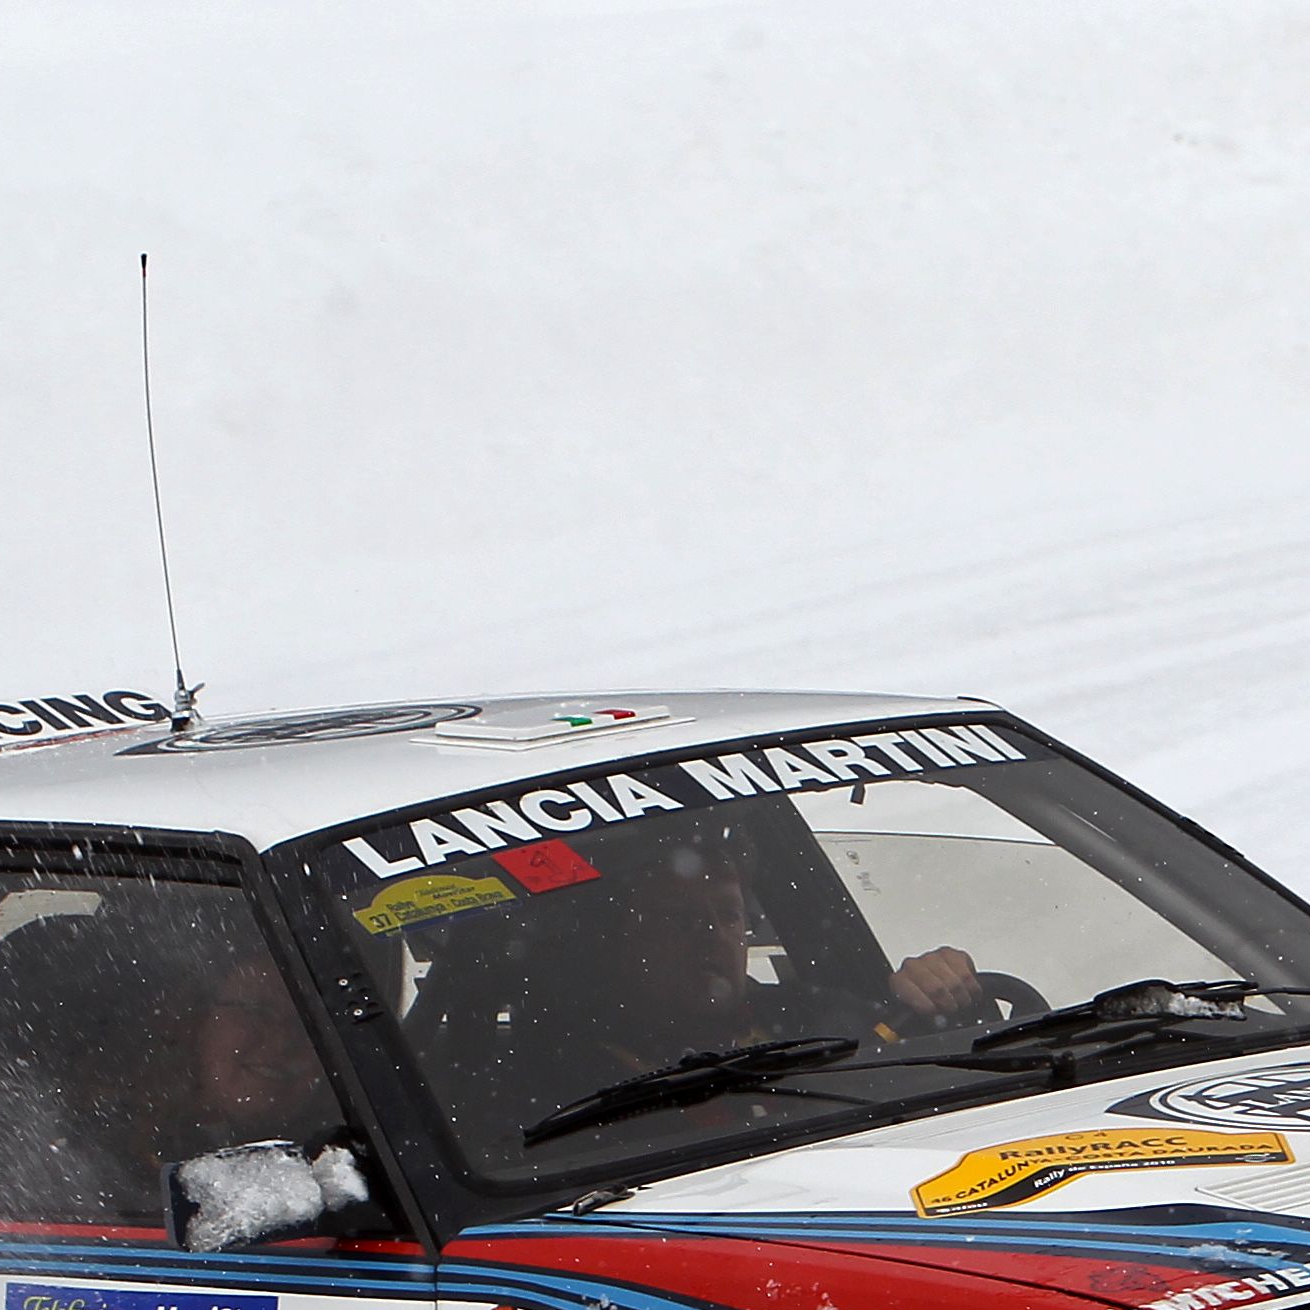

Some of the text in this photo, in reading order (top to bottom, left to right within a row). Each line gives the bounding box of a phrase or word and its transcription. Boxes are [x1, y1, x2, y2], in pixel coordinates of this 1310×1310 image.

[342, 725, 1027, 879] LANCIA MARTINI
[369, 912, 393, 929] 37
[999, 1136, 1187, 1161] RallyRACC
[1153, 1144, 1274, 1155] DAURADA
[1033, 1168, 1066, 1189] Rally
